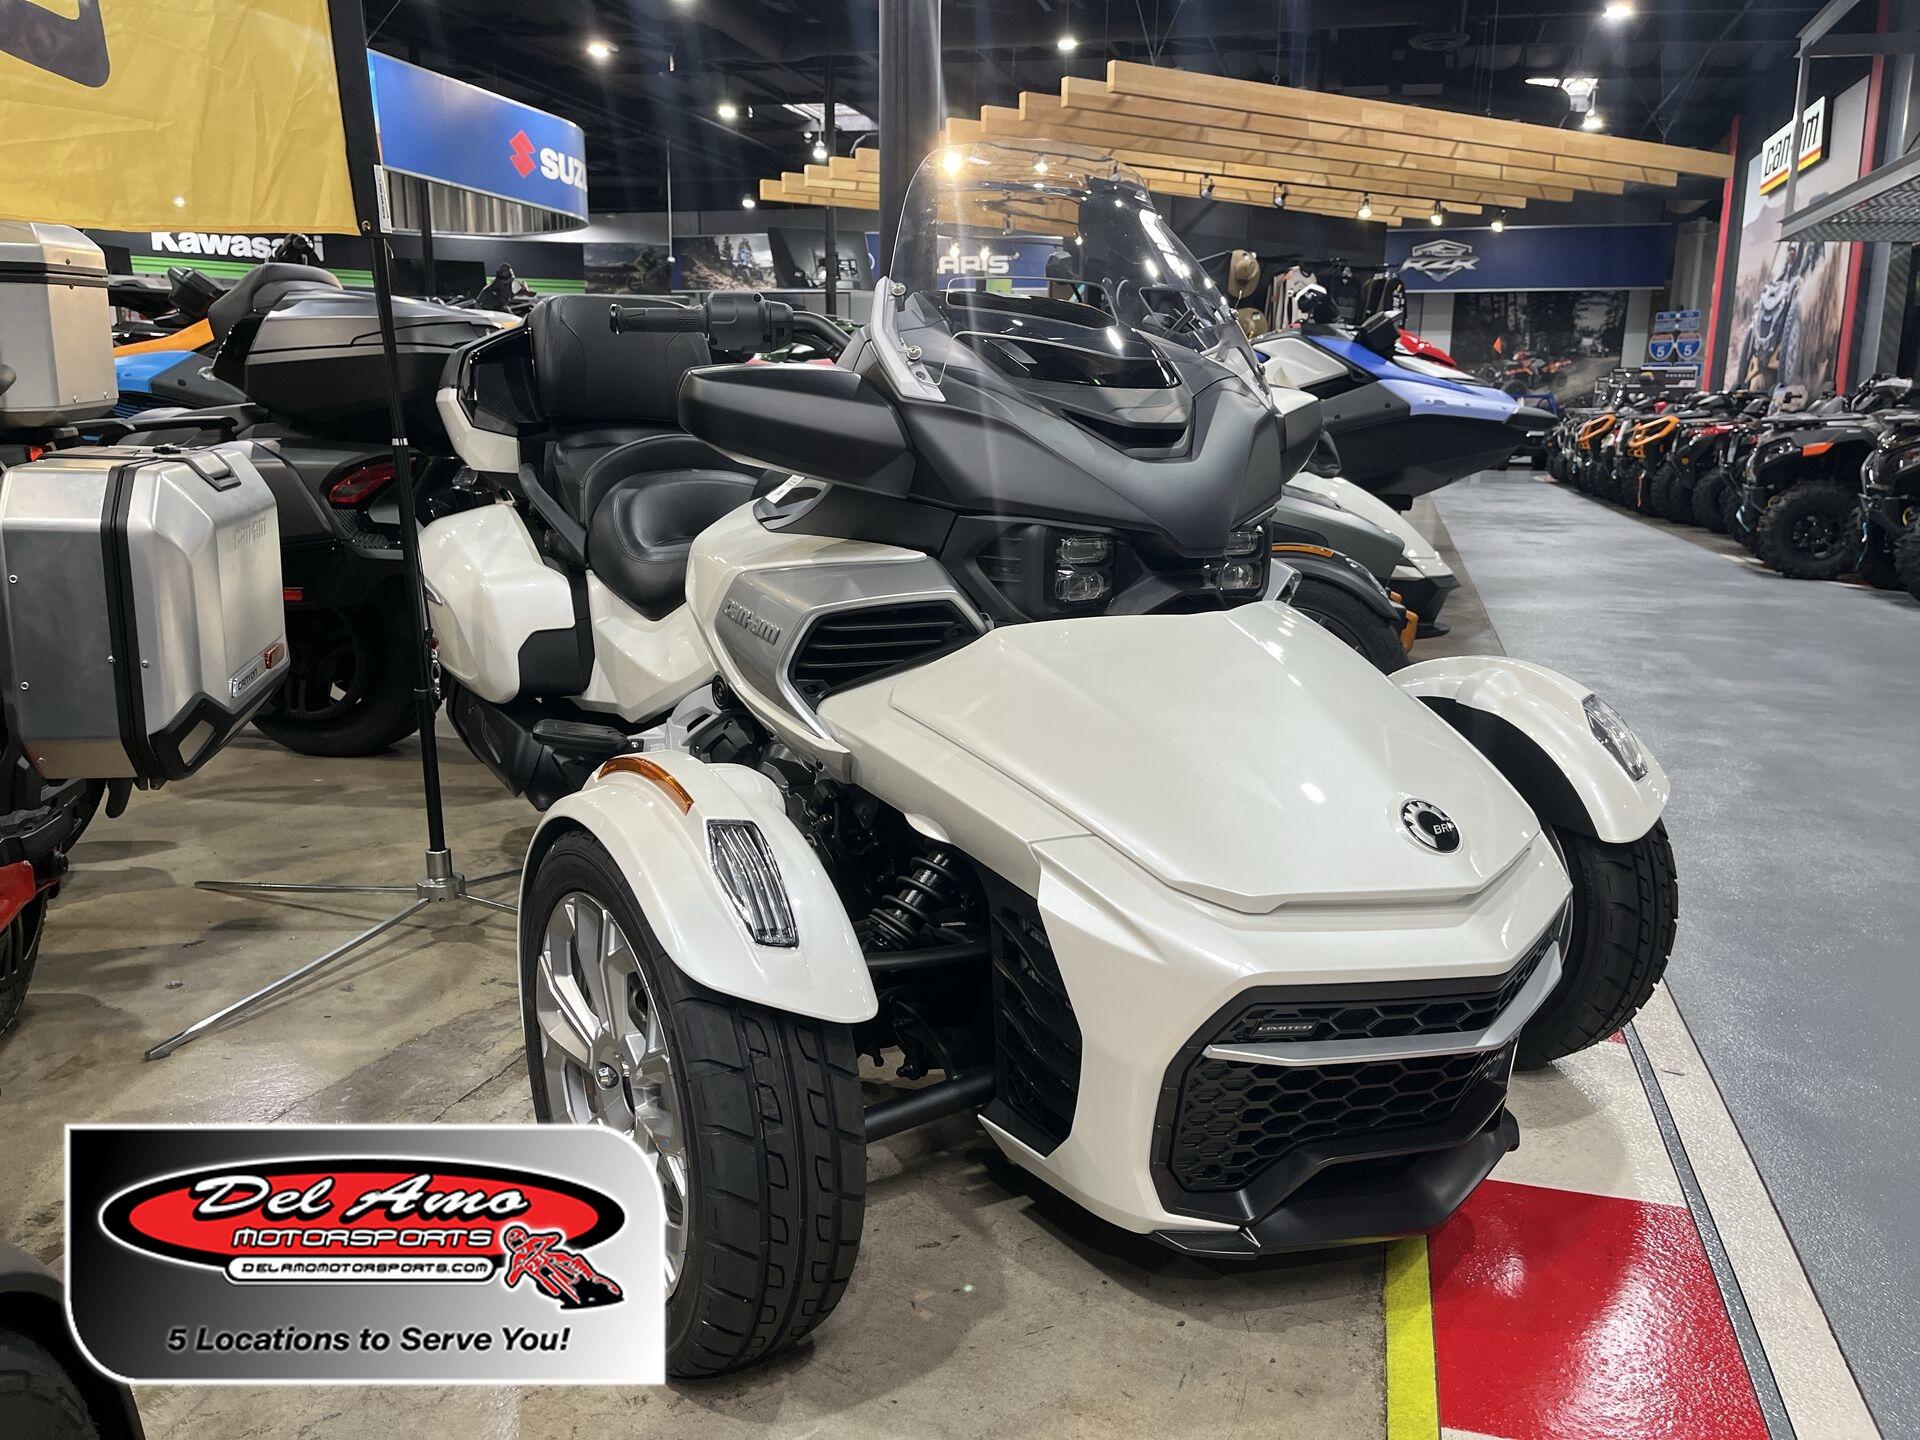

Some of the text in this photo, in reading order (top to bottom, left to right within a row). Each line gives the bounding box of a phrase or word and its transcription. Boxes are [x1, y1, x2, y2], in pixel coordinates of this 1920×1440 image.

[151, 231, 325, 263] Kawasi
[938, 255, 1009, 274] ARIS
[1399, 256, 1479, 273] RZR
[1656, 345, 1665, 358] 5
[1683, 344, 1693, 357] 5
